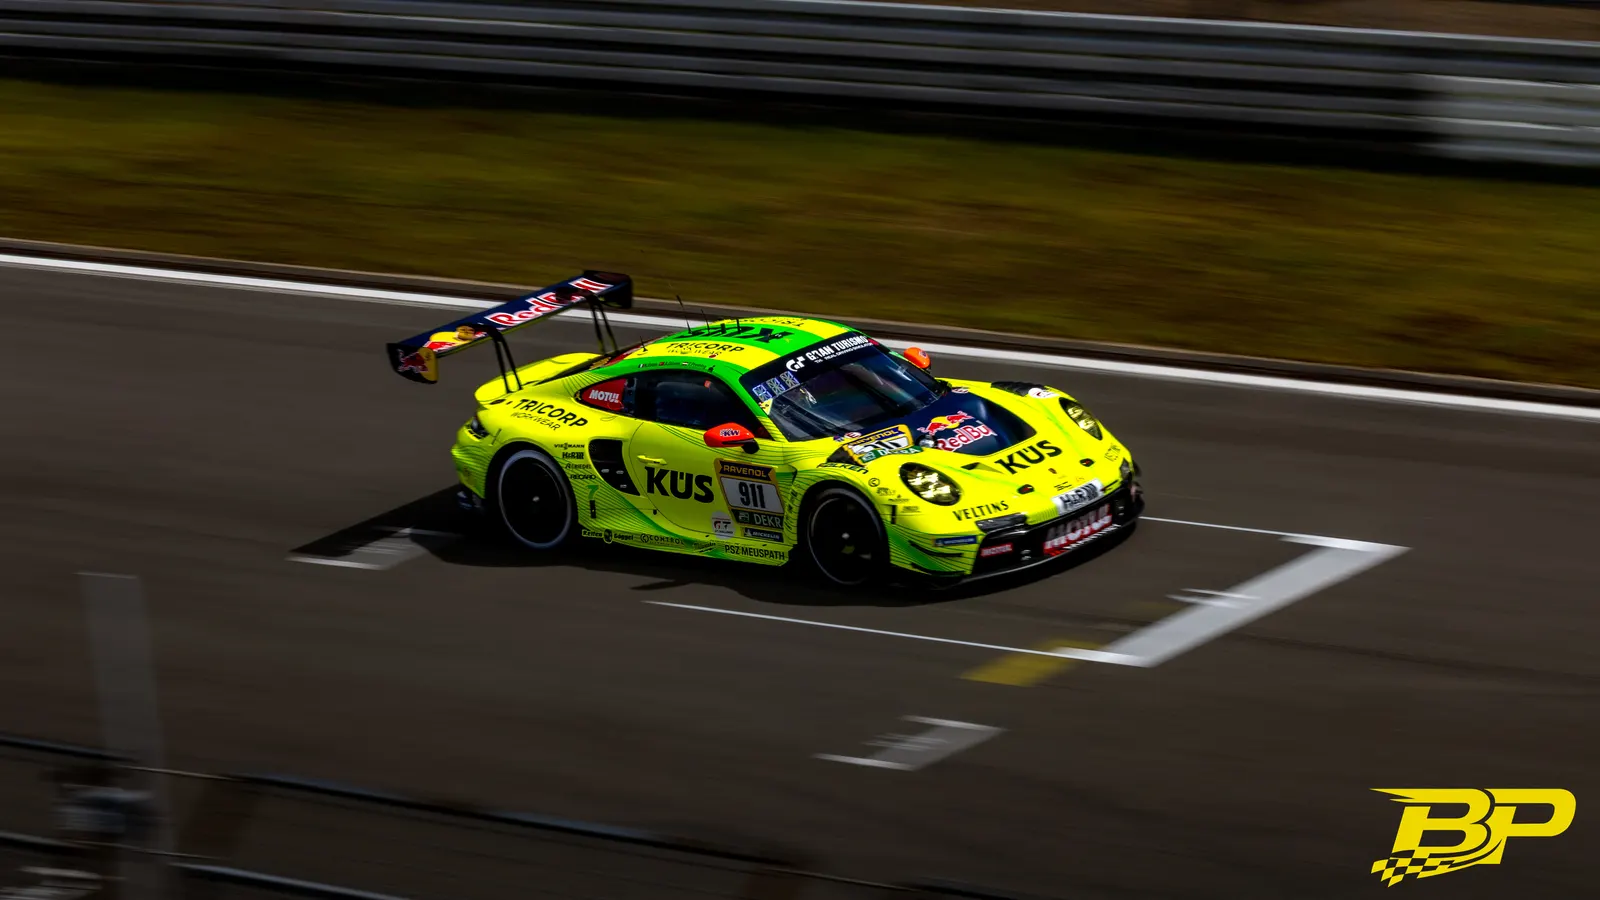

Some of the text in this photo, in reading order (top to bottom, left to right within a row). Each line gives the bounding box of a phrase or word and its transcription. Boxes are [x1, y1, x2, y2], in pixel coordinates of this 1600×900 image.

[666, 342, 745, 352] TRICORP
[830, 335, 868, 351] TURISMO
[589, 390, 620, 403] MOTUL
[511, 411, 561, 431] WORKWEAR
[513, 399, 588, 427] TRICORP
[994, 440, 1063, 475] KÜS
[723, 464, 767, 478] RAVENOL
[644, 466, 714, 503] KÜS
[738, 481, 766, 509] 911
[953, 501, 1010, 521] VELTINS
[753, 513, 782, 528] DEKR
[752, 531, 780, 540] MICHELIN
[724, 544, 740, 554] PSZ
[741, 548, 785, 560] MEUSPATH
